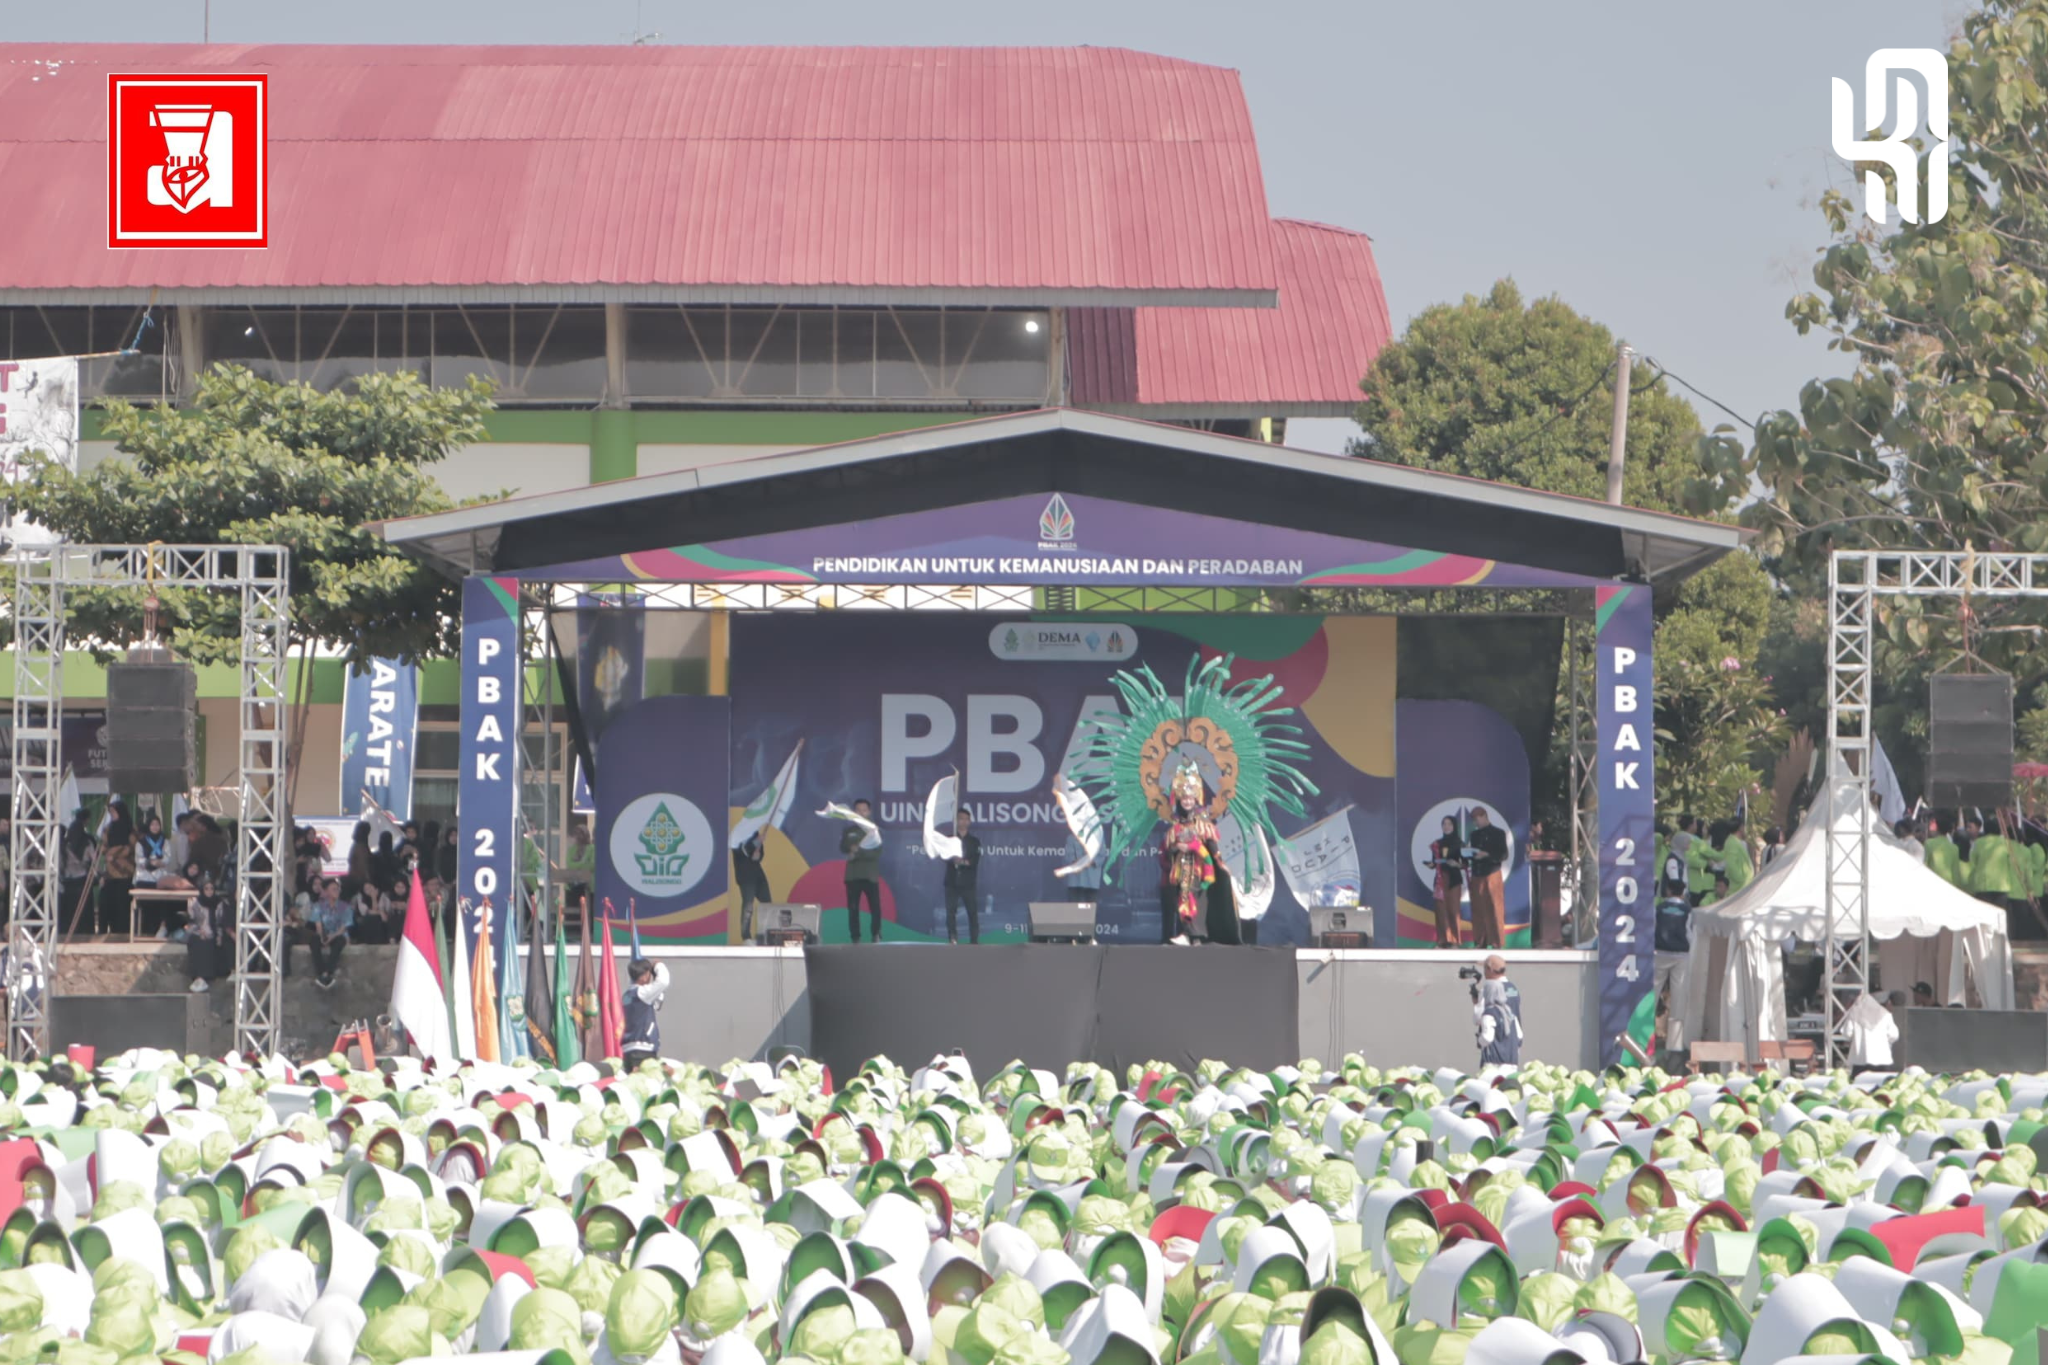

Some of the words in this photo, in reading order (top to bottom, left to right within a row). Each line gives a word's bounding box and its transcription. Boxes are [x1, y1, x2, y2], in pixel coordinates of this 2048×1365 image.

[812, 557, 928, 573] PENDIDIKAN
[931, 558, 996, 573] UNTUK
[1000, 558, 1139, 574] KEMANUSIAAN
[1143, 559, 1184, 574] DAN
[1188, 559, 1303, 575] PERADABAN
[1038, 632, 1081, 643] DEMA
[364, 658, 397, 787] ARATE
[475, 638, 503, 780] PBAK
[1613, 646, 1641, 790] PBAK
[880, 802, 923, 822] UIN
[950, 802, 1075, 823] ALISONG
[987, 846, 1025, 856] Untuk
[1291, 835, 1350, 873] PIAUD
[1614, 837, 1640, 982] 2024
[1094, 923, 1119, 935] 024
